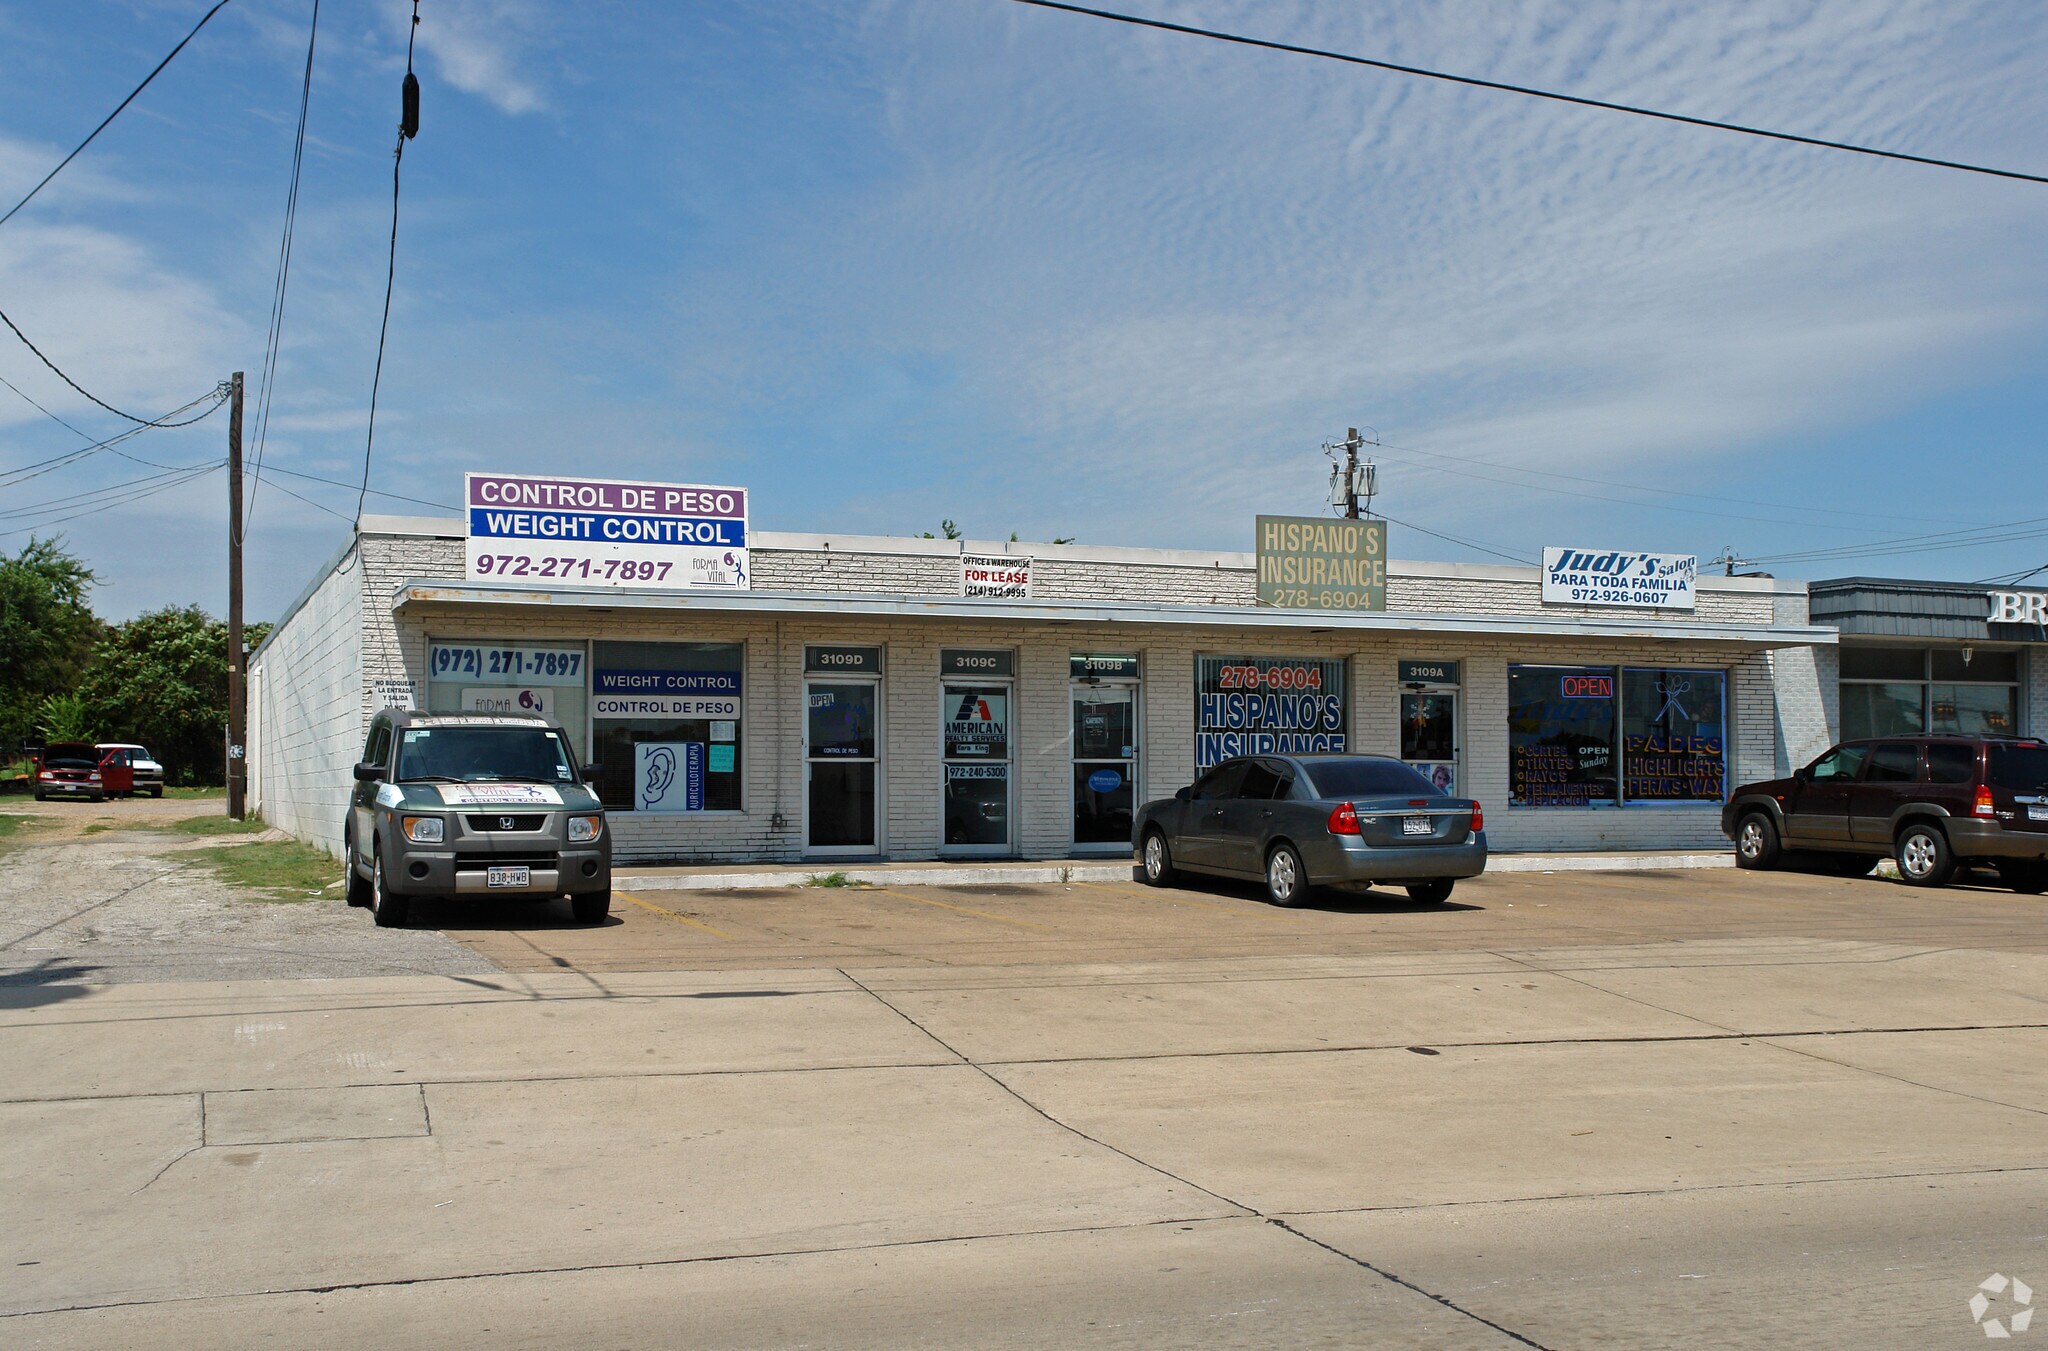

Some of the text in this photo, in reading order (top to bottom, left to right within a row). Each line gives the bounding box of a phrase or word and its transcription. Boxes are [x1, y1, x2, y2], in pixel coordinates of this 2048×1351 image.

[480, 481, 735, 514] CONTROL DE PESO
[486, 512, 731, 543] WEIGHT CONTROL
[1265, 523, 1379, 555] HISPANO'S
[476, 554, 673, 581] 972-271-7897
[692, 558, 718, 570] FORMA
[963, 557, 986, 566] OFFICE
[991, 559, 1030, 568] WAREHOUSE
[1548, 549, 1695, 578] Judy's Salon
[707, 571, 727, 582] VITAL
[964, 570, 1028, 583] FOR LEASE
[1260, 556, 1383, 587] INSURANCE
[1551, 573, 1687, 591] PARA TODA FAMILIA
[964, 585, 1026, 598] (214) 912-9995
[1274, 589, 1371, 609] 278-6904
[1571, 588, 1668, 604] 972-926-0607
[1987, 590, 2048, 625] BR
[431, 647, 582, 679] (972) 271-7897
[821, 653, 863, 665] 3109D
[956, 656, 996, 668] 3109C
[1084, 659, 1122, 671] 3109B
[1220, 666, 1321, 689] 278-6904
[1410, 667, 1444, 677] 3109A
[602, 674, 736, 690] WEIGHT CONTROL
[1564, 678, 1611, 696] OPEN
[596, 700, 734, 715] CONTROL DE PESO
[810, 694, 833, 706] OPEN
[1200, 693, 1341, 730] HISPANO'S
[945, 722, 1003, 734] AMERICAN
[975, 745, 989, 753] King
[1626, 735, 1722, 754] FADES
[1525, 757, 1574, 770] TINTES
[1579, 755, 1609, 770] Sunday
[1627, 758, 1726, 777] HIGHLIGHTS
[690, 744, 699, 809] AURICULOTERAPIA
[1525, 770, 1567, 782] RAYOS
